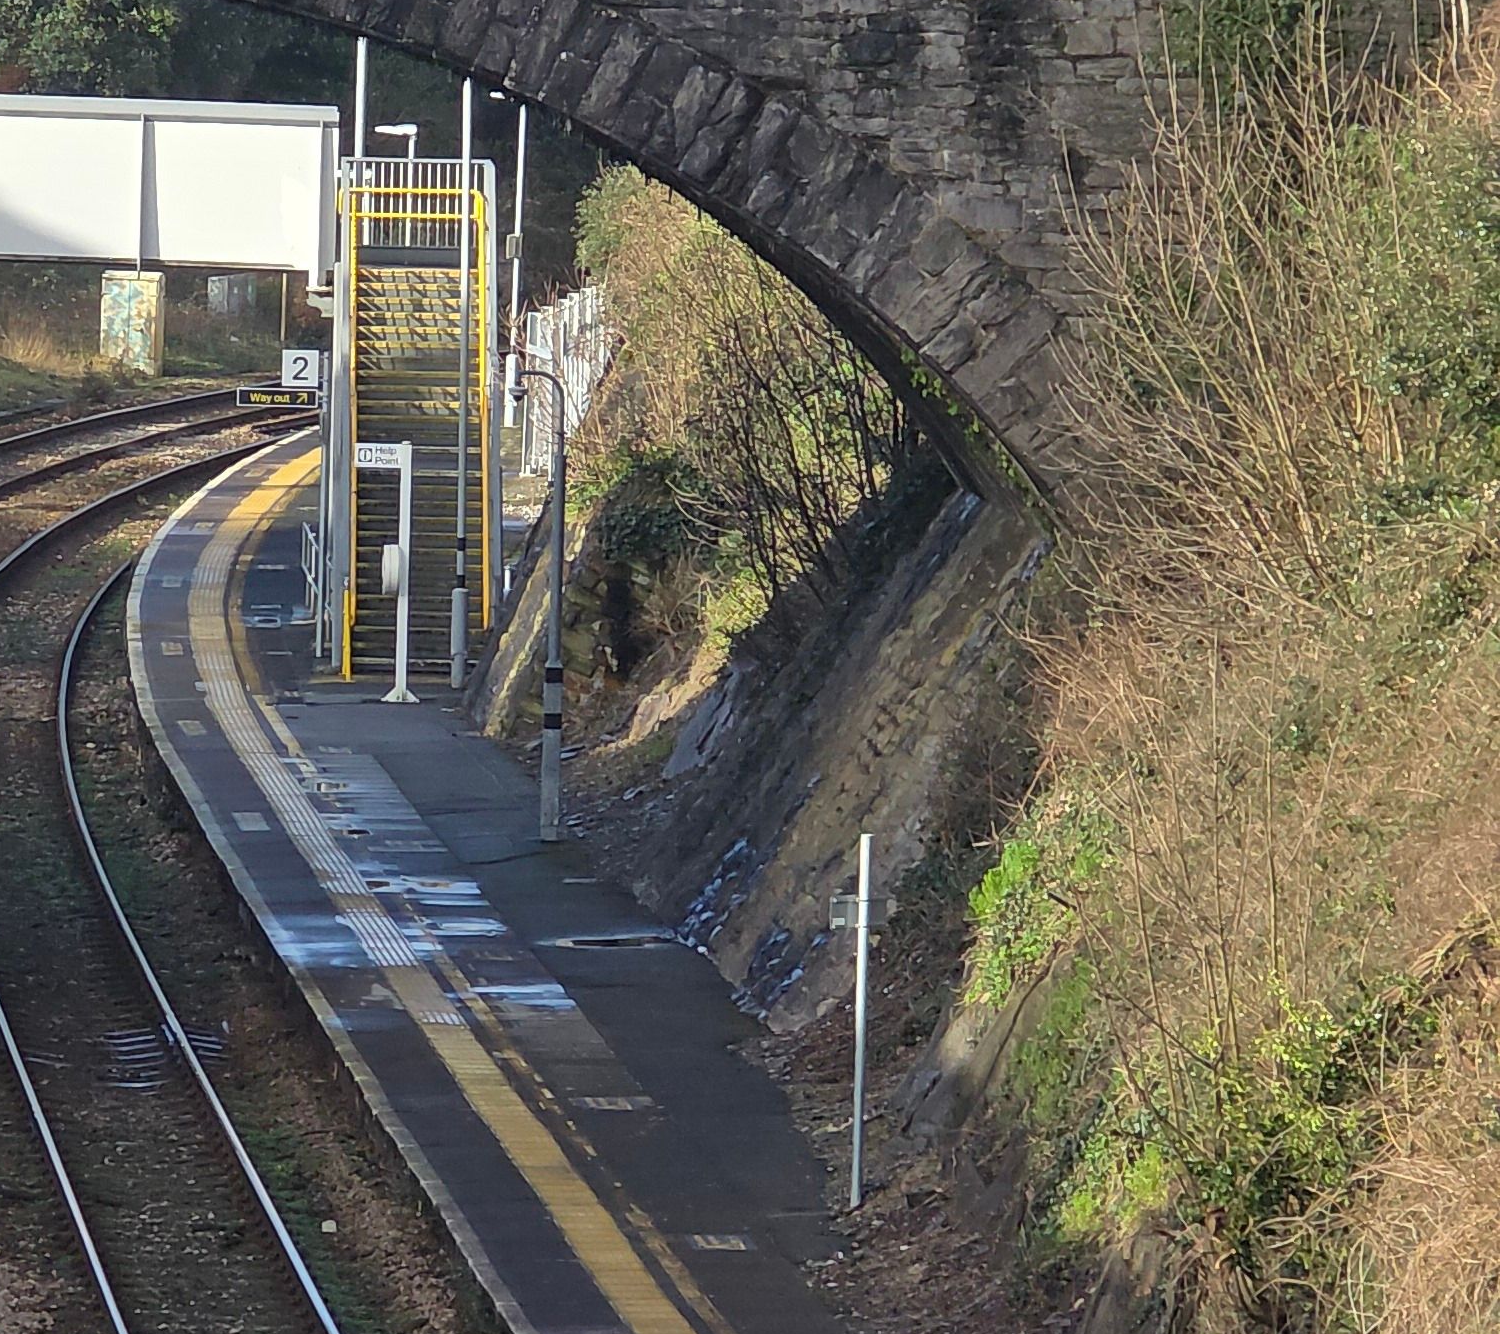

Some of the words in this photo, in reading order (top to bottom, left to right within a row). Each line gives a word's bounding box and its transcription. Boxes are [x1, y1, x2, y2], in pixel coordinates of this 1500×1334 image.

[292, 356, 309, 381] 2
[249, 392, 272, 404] Way
[273, 394, 291, 403] out
[375, 446, 397, 456] Help
[375, 457, 399, 465] Point
